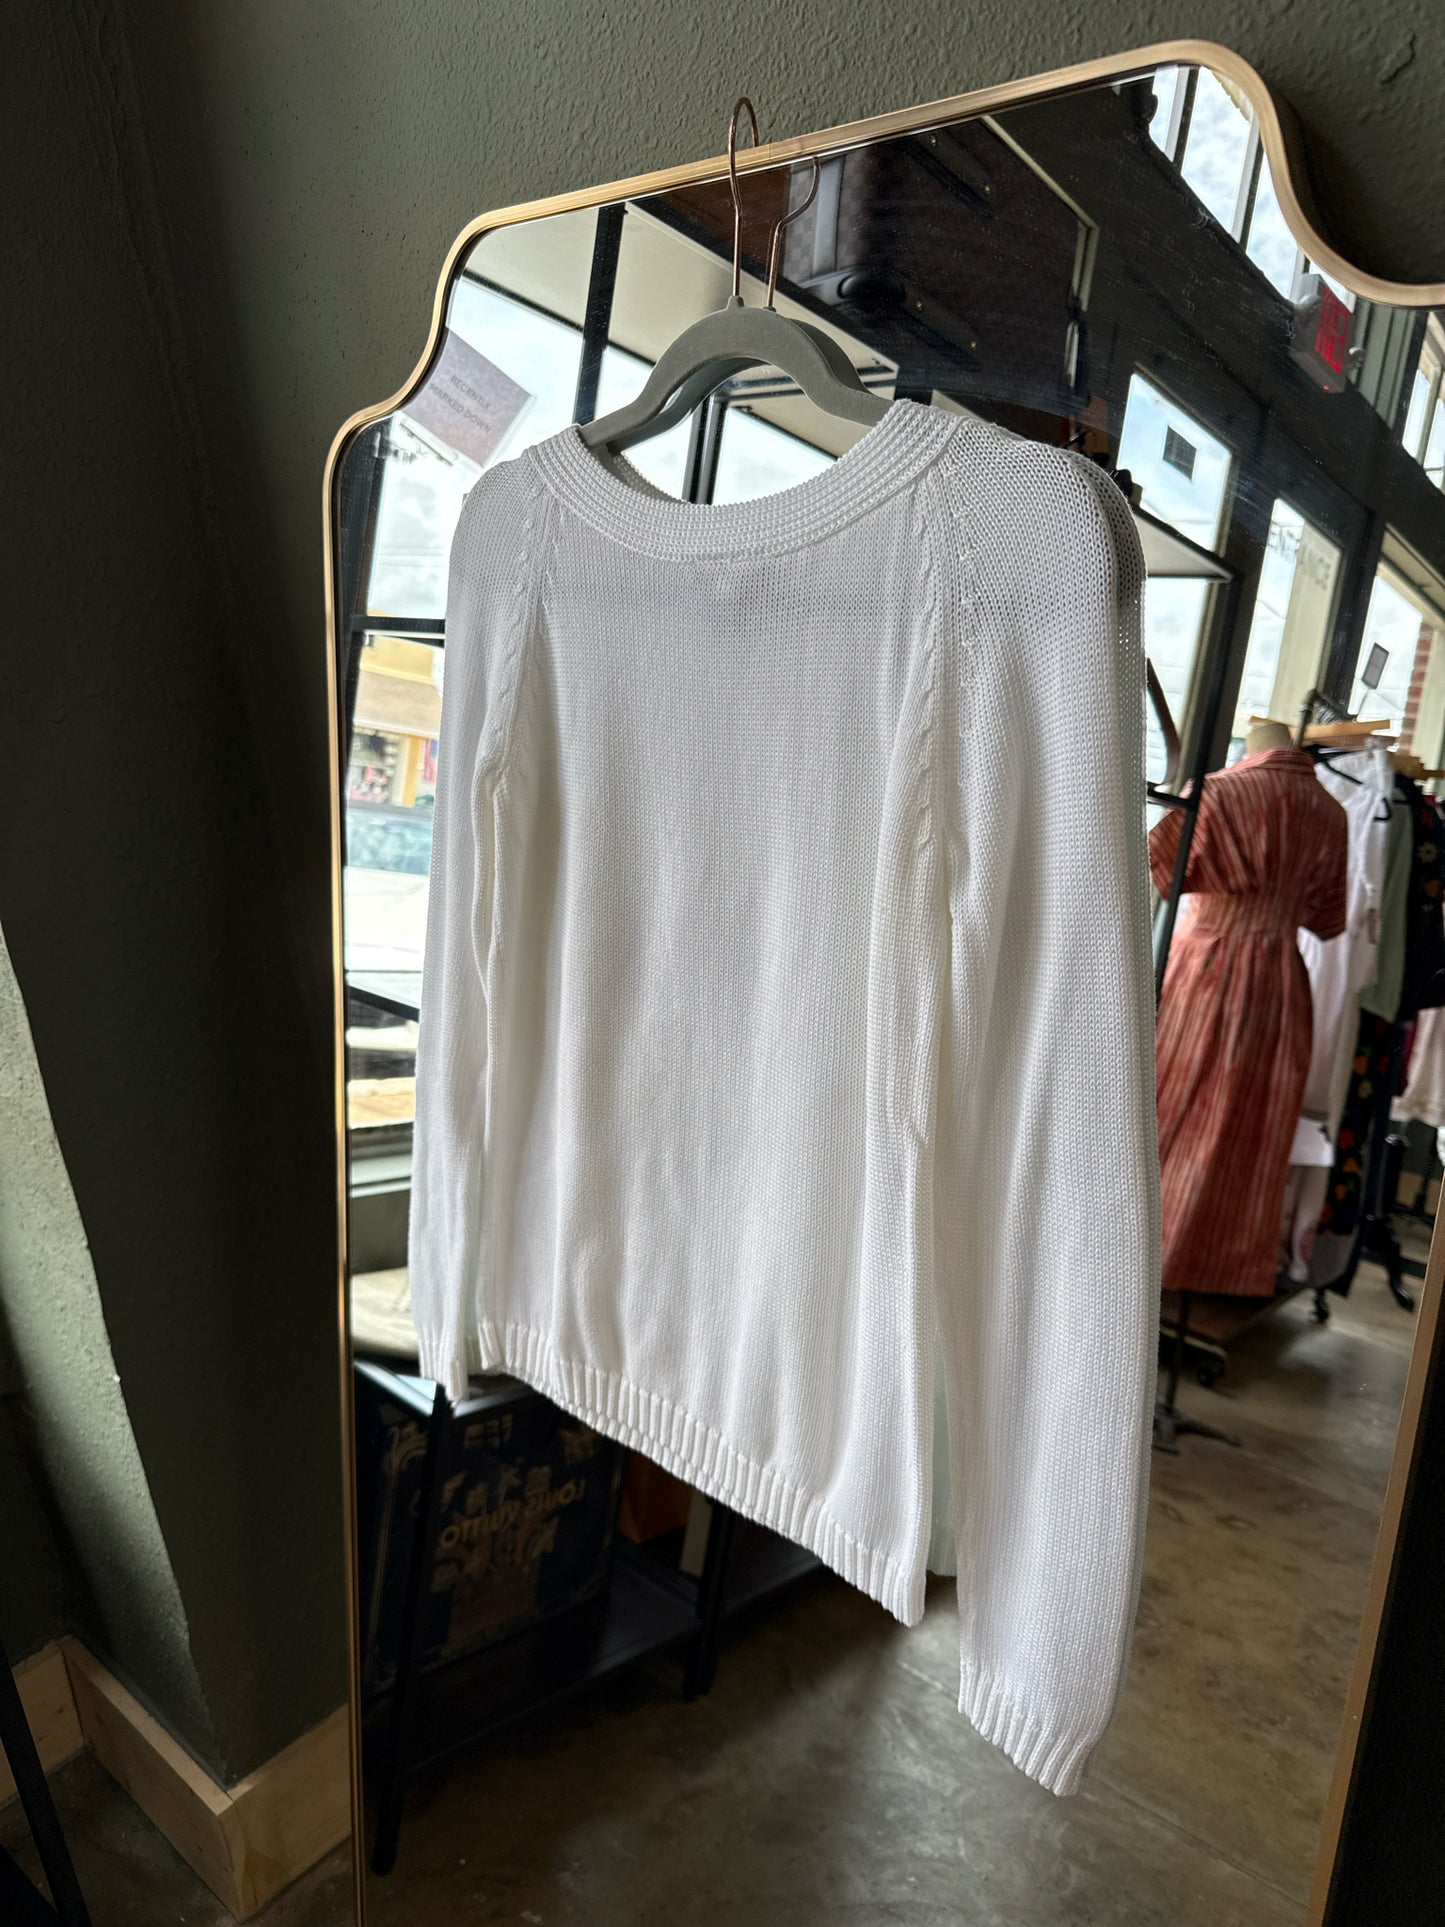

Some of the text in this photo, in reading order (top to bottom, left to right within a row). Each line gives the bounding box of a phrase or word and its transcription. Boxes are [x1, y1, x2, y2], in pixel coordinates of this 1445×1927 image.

[430, 383, 491, 433] MARKED DOWN
[450, 375, 491, 409] RECENTLY
